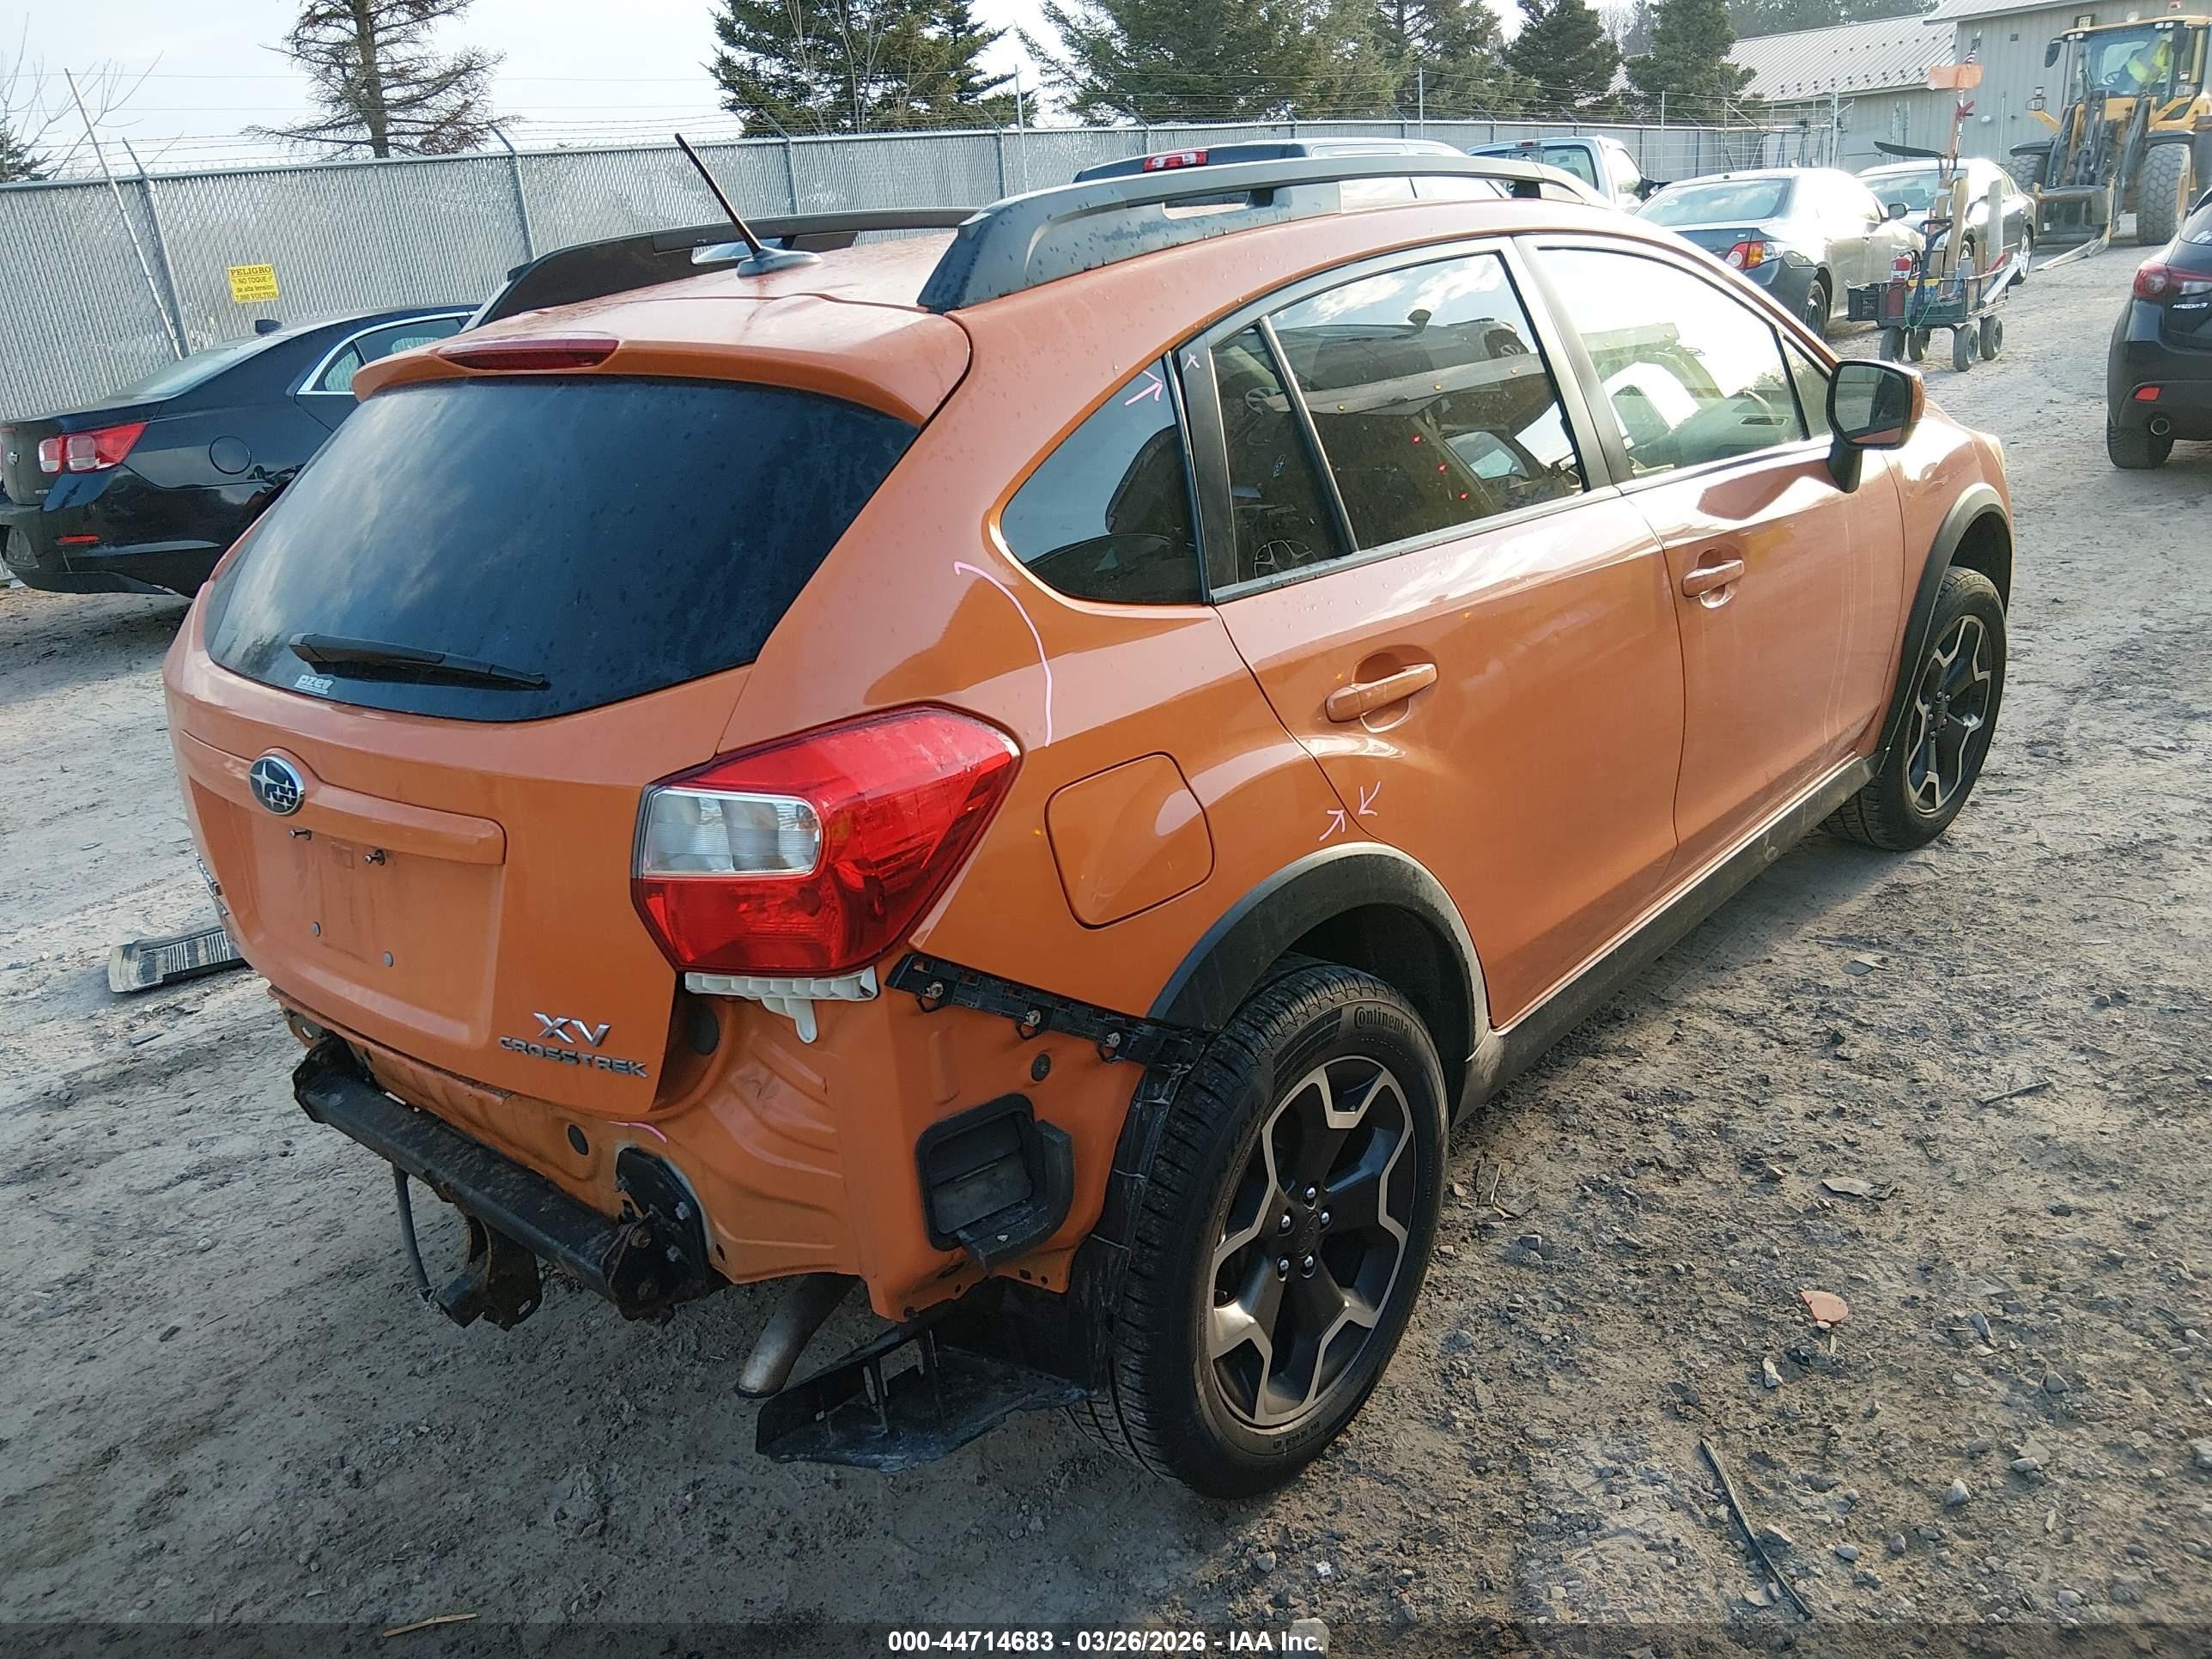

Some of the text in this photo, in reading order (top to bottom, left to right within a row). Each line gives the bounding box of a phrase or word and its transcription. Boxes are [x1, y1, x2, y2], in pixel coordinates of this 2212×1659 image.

[230, 266, 271, 276] PELIGRO
[251, 291, 277, 300] VOLTIOS
[533, 1012, 611, 1048] XV
[1353, 1006, 1413, 1039] Continental
[498, 1036, 647, 1079] CROSSTREK
